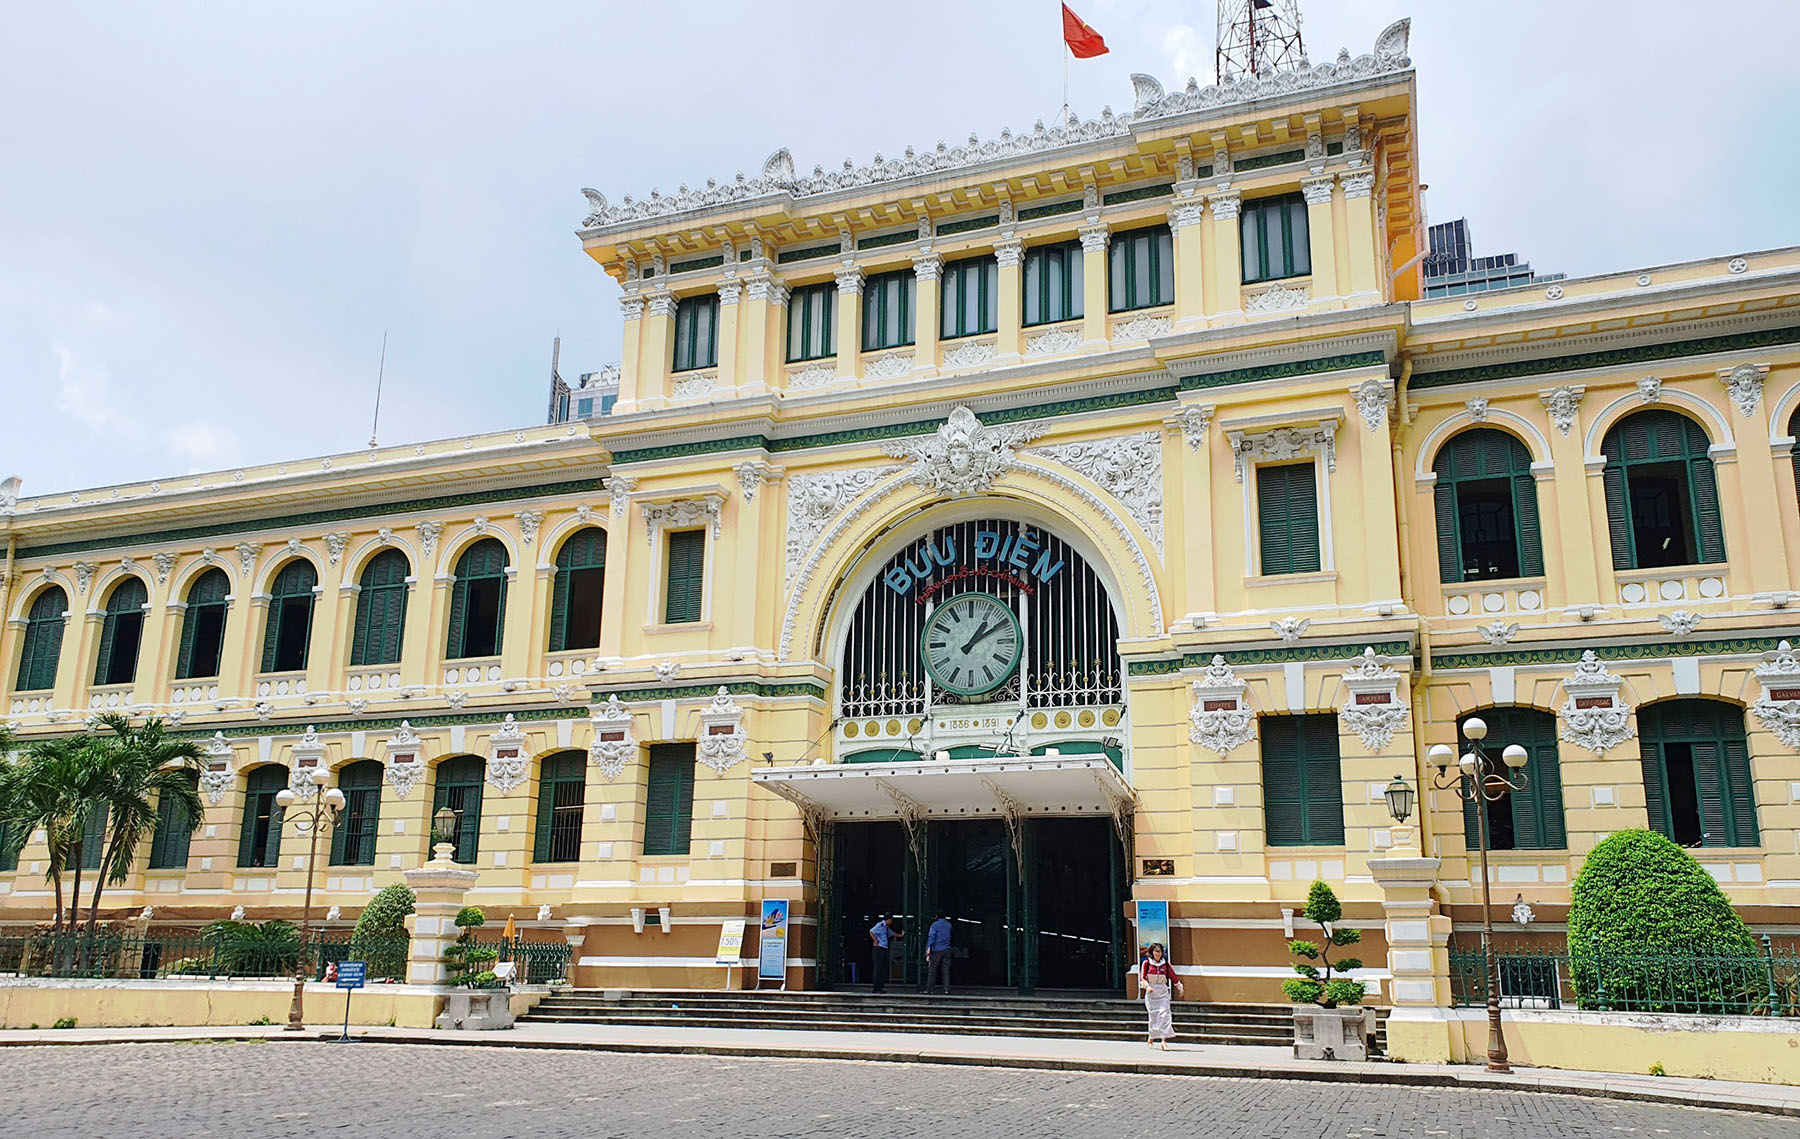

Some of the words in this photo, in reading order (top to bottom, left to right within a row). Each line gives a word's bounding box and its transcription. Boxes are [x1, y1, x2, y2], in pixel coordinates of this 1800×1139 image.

[974, 531, 1065, 584] ĐIỆN
[1008, 575, 1035, 596] MINH
[949, 719, 970, 730] 1886
[982, 717, 1000, 729] 1891
